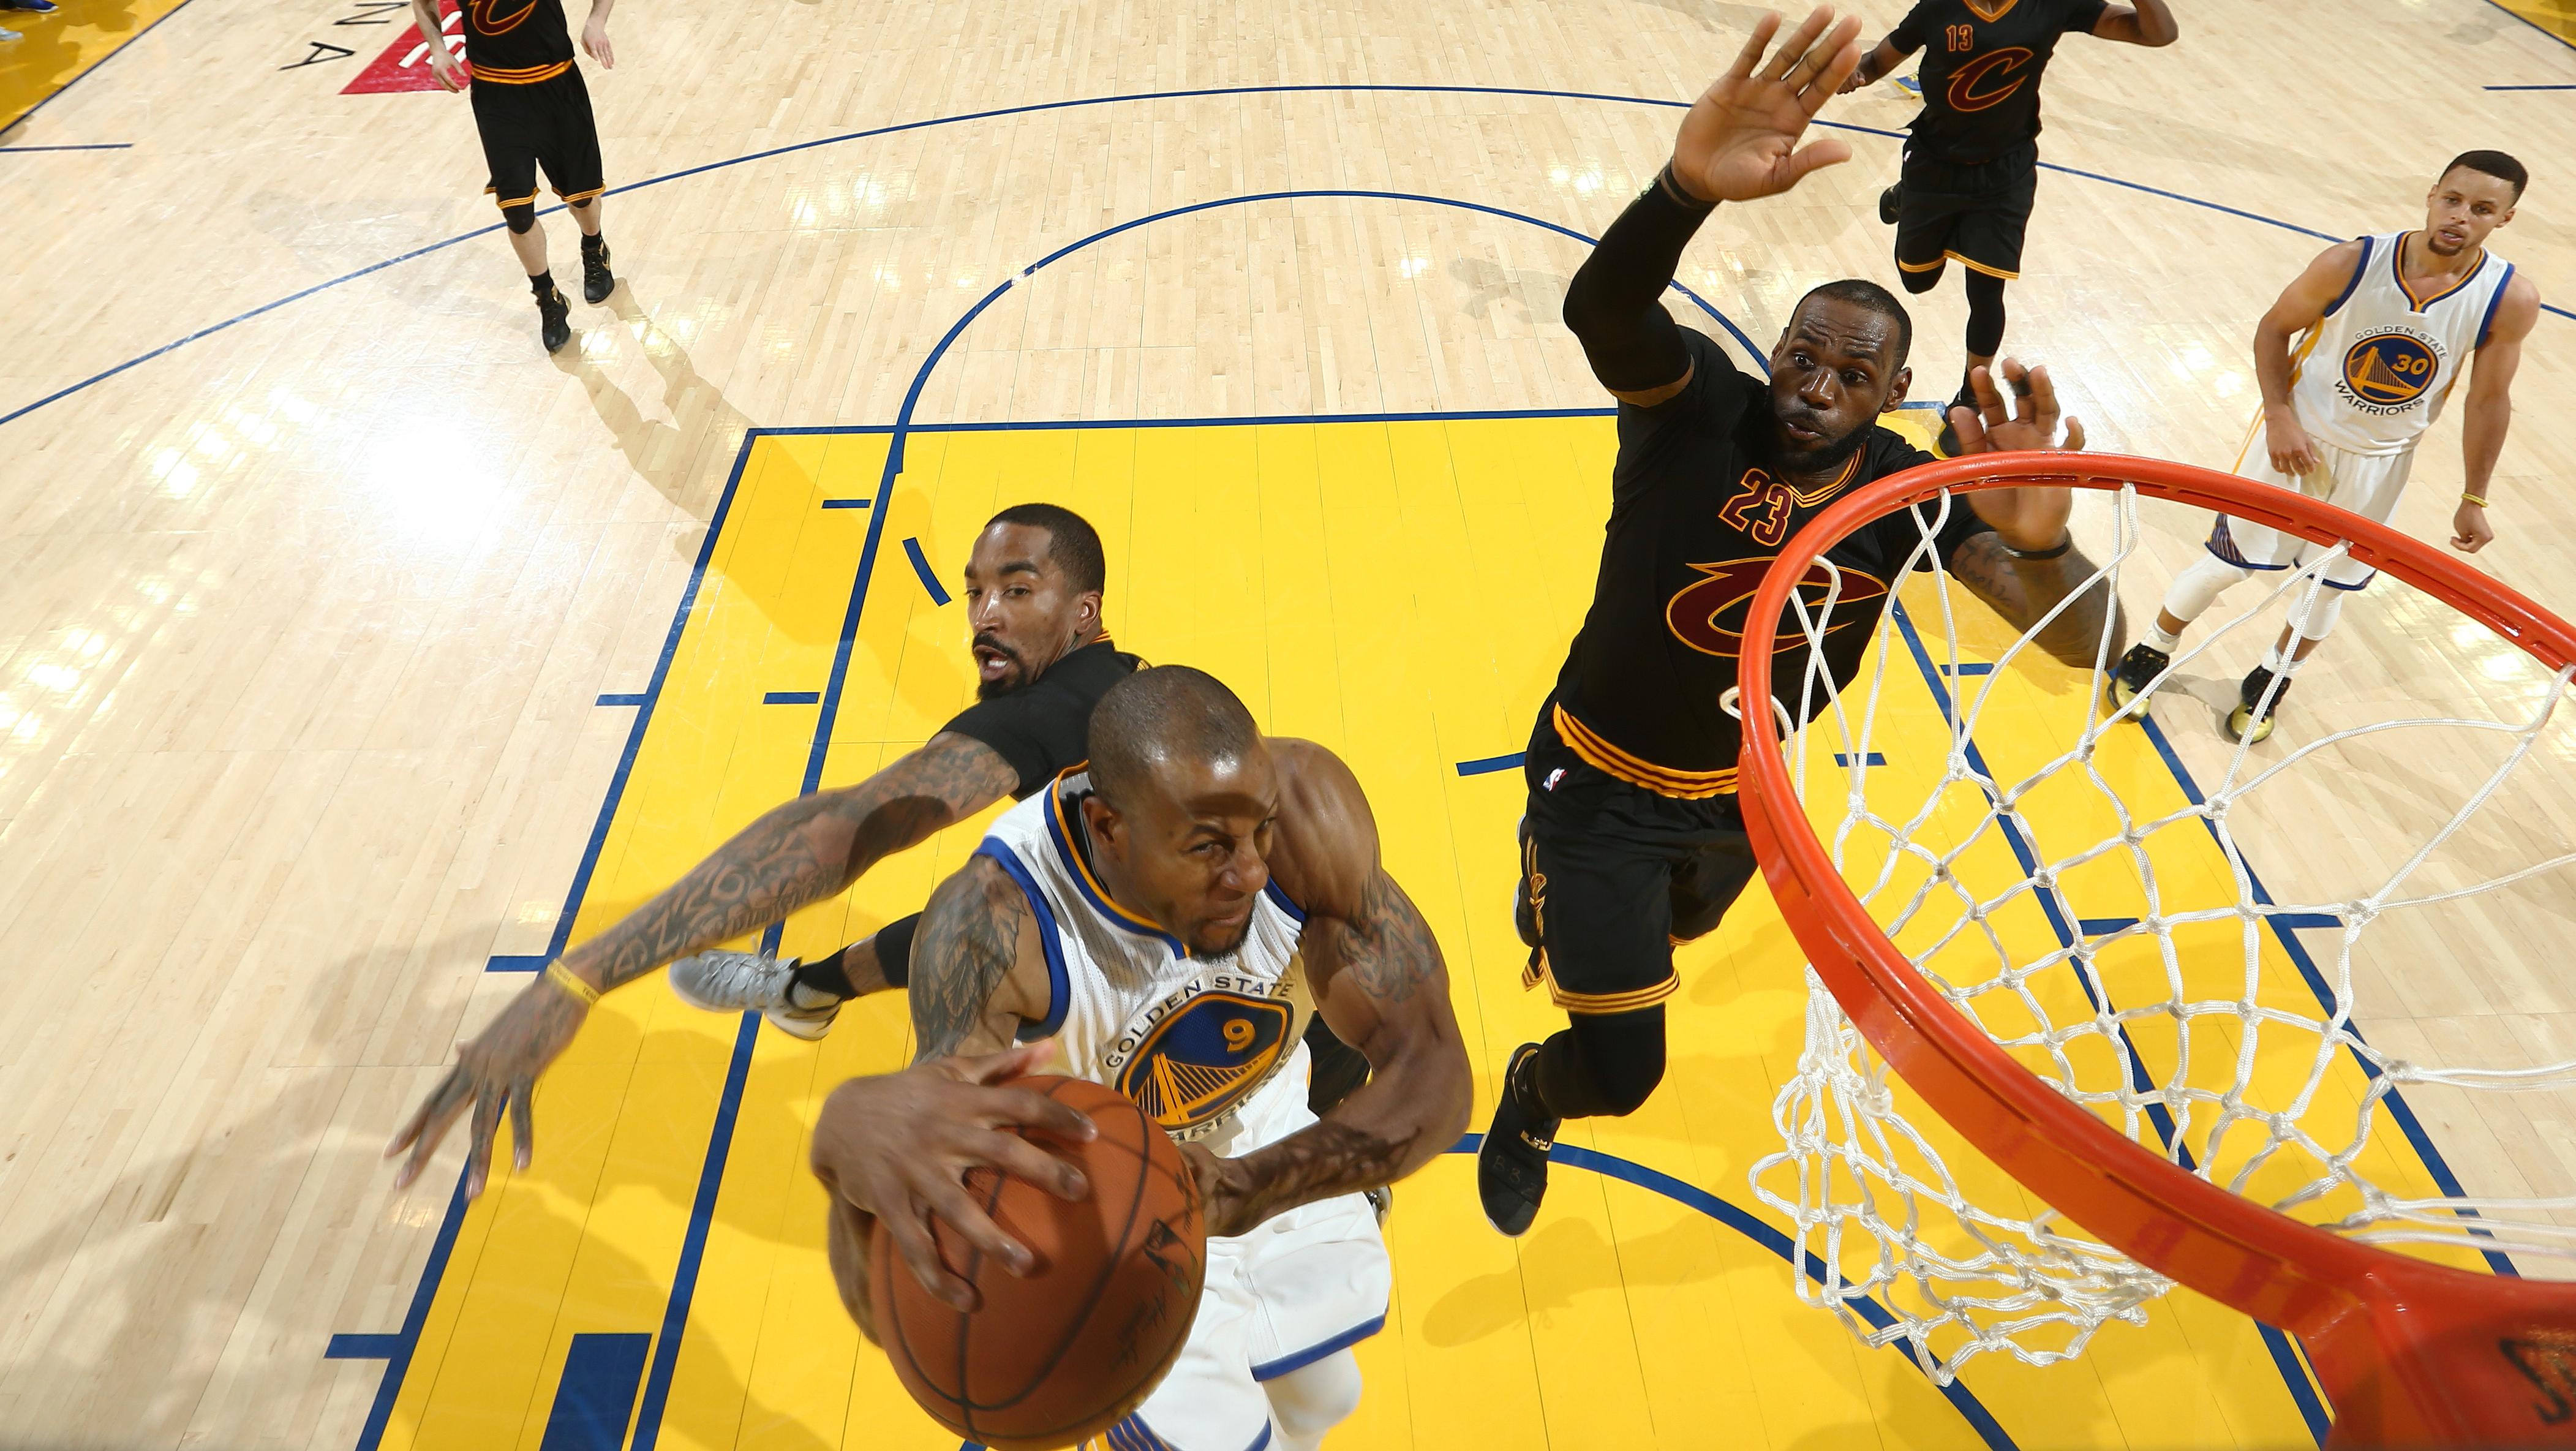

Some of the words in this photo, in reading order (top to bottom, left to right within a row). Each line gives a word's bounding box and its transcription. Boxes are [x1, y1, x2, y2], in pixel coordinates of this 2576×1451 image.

[1946, 24, 1973, 52] 13
[1947, 47, 2035, 112] C
[2355, 325, 2416, 341] GOLDEN
[2419, 331, 2449, 360] STATE
[2391, 353, 2430, 376] 30
[2334, 379, 2425, 416] WARRIORS
[1717, 467, 1795, 547] 23
[1105, 978, 1203, 1069] GOLDEN
[1215, 976, 1294, 997] STATE
[1222, 1018, 1257, 1053] 9
